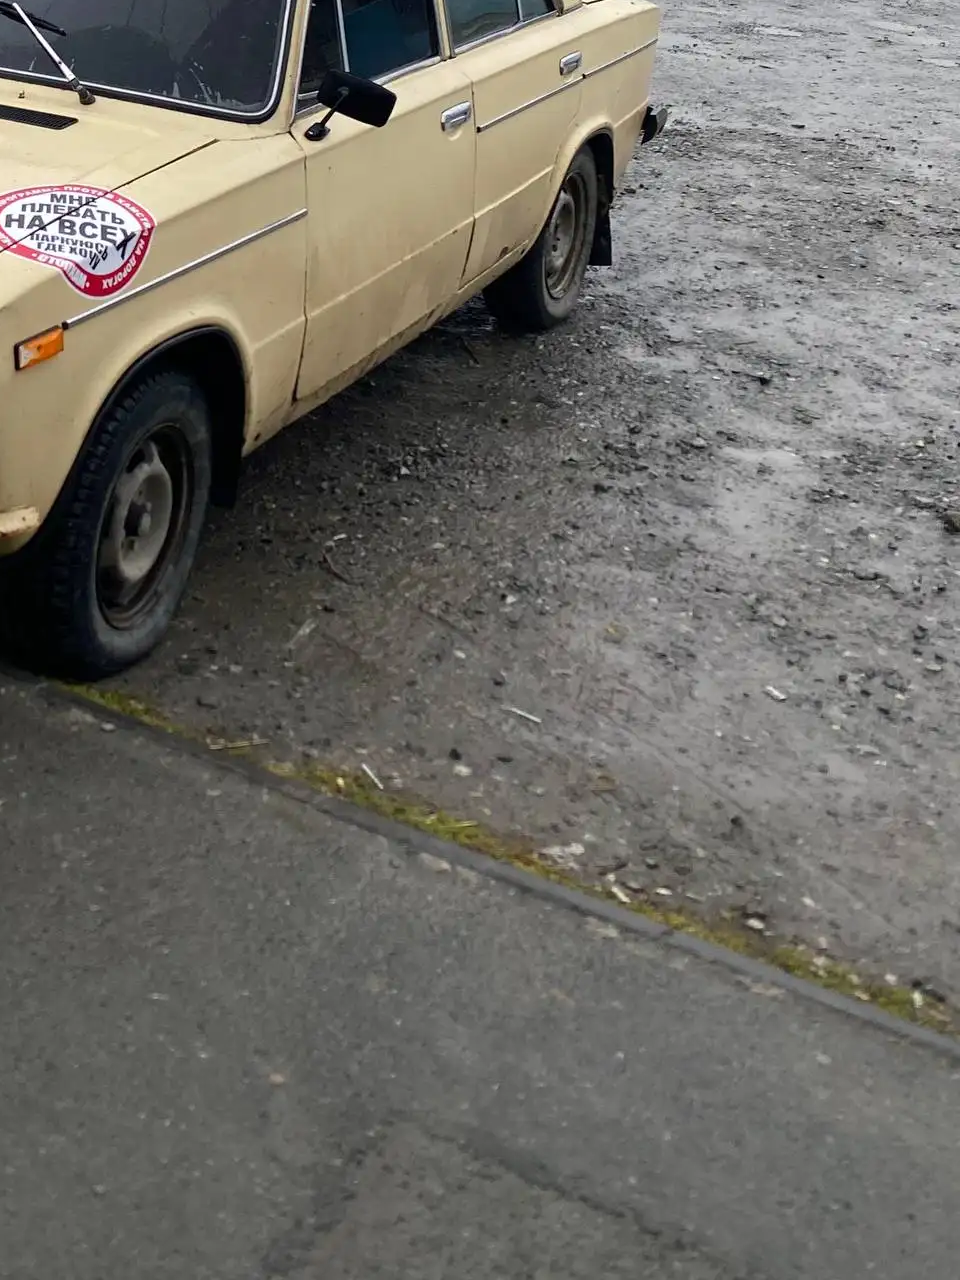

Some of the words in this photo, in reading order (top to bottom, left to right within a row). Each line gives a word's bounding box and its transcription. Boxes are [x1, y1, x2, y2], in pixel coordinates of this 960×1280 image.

[21, 202, 125, 225] ПЛЕВАТЬ
[50, 193, 98, 208] МНЕ
[4, 214, 47, 233] НА
[58, 219, 137, 260] ВСЕХ
[29, 233, 109, 262] ПАРКУЮСЬ
[63, 185, 115, 200] ПРОТИВ
[101, 255, 138, 290] ДОРОГАХ
[37, 242, 66, 254] ГДЕ
[69, 246, 102, 270] ХОЧУ
